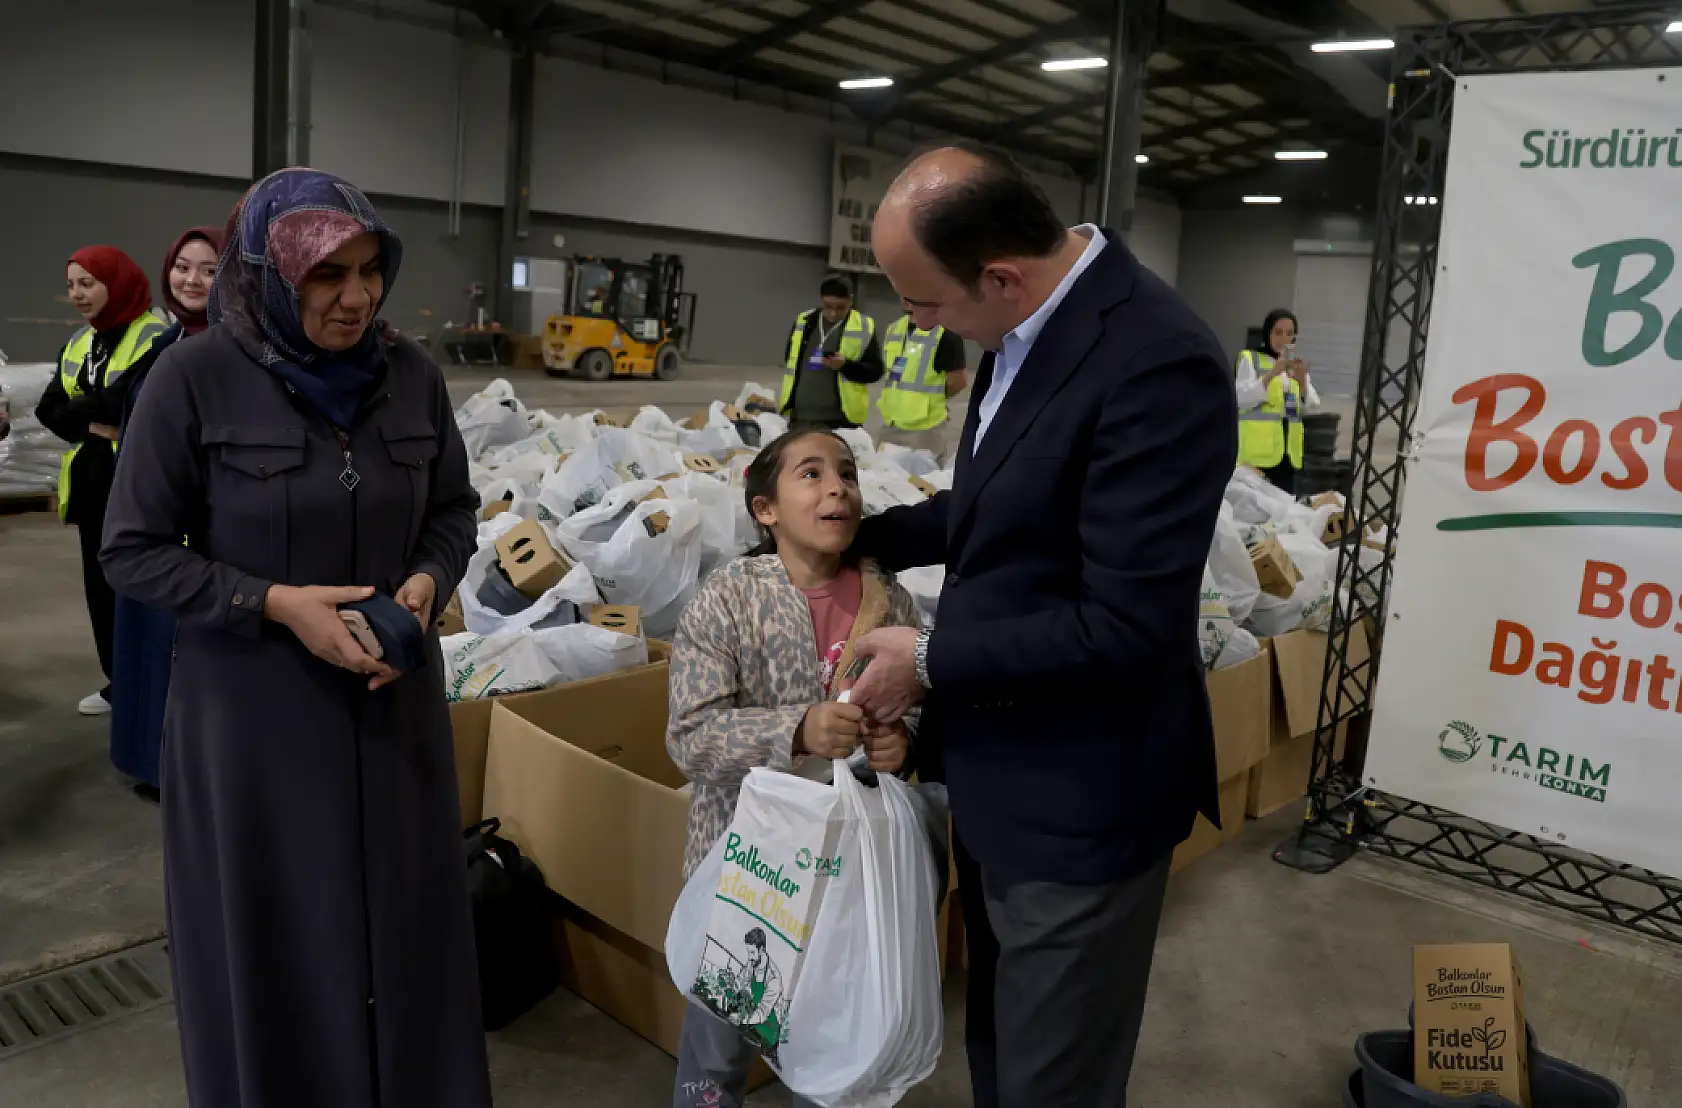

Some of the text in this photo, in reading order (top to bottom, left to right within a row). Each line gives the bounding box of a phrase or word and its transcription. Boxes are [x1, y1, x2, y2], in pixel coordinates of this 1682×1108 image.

[1578, 559, 1682, 634] Bos
[1487, 734, 1612, 788] TARIM
[723, 831, 801, 899] Balkonlar
[1436, 967, 1493, 982] Balkonlar
[1425, 979, 1506, 998] Bostan Olsun
[1427, 1028, 1473, 1049] Fide
[1427, 1050, 1504, 1072] Kutusu
